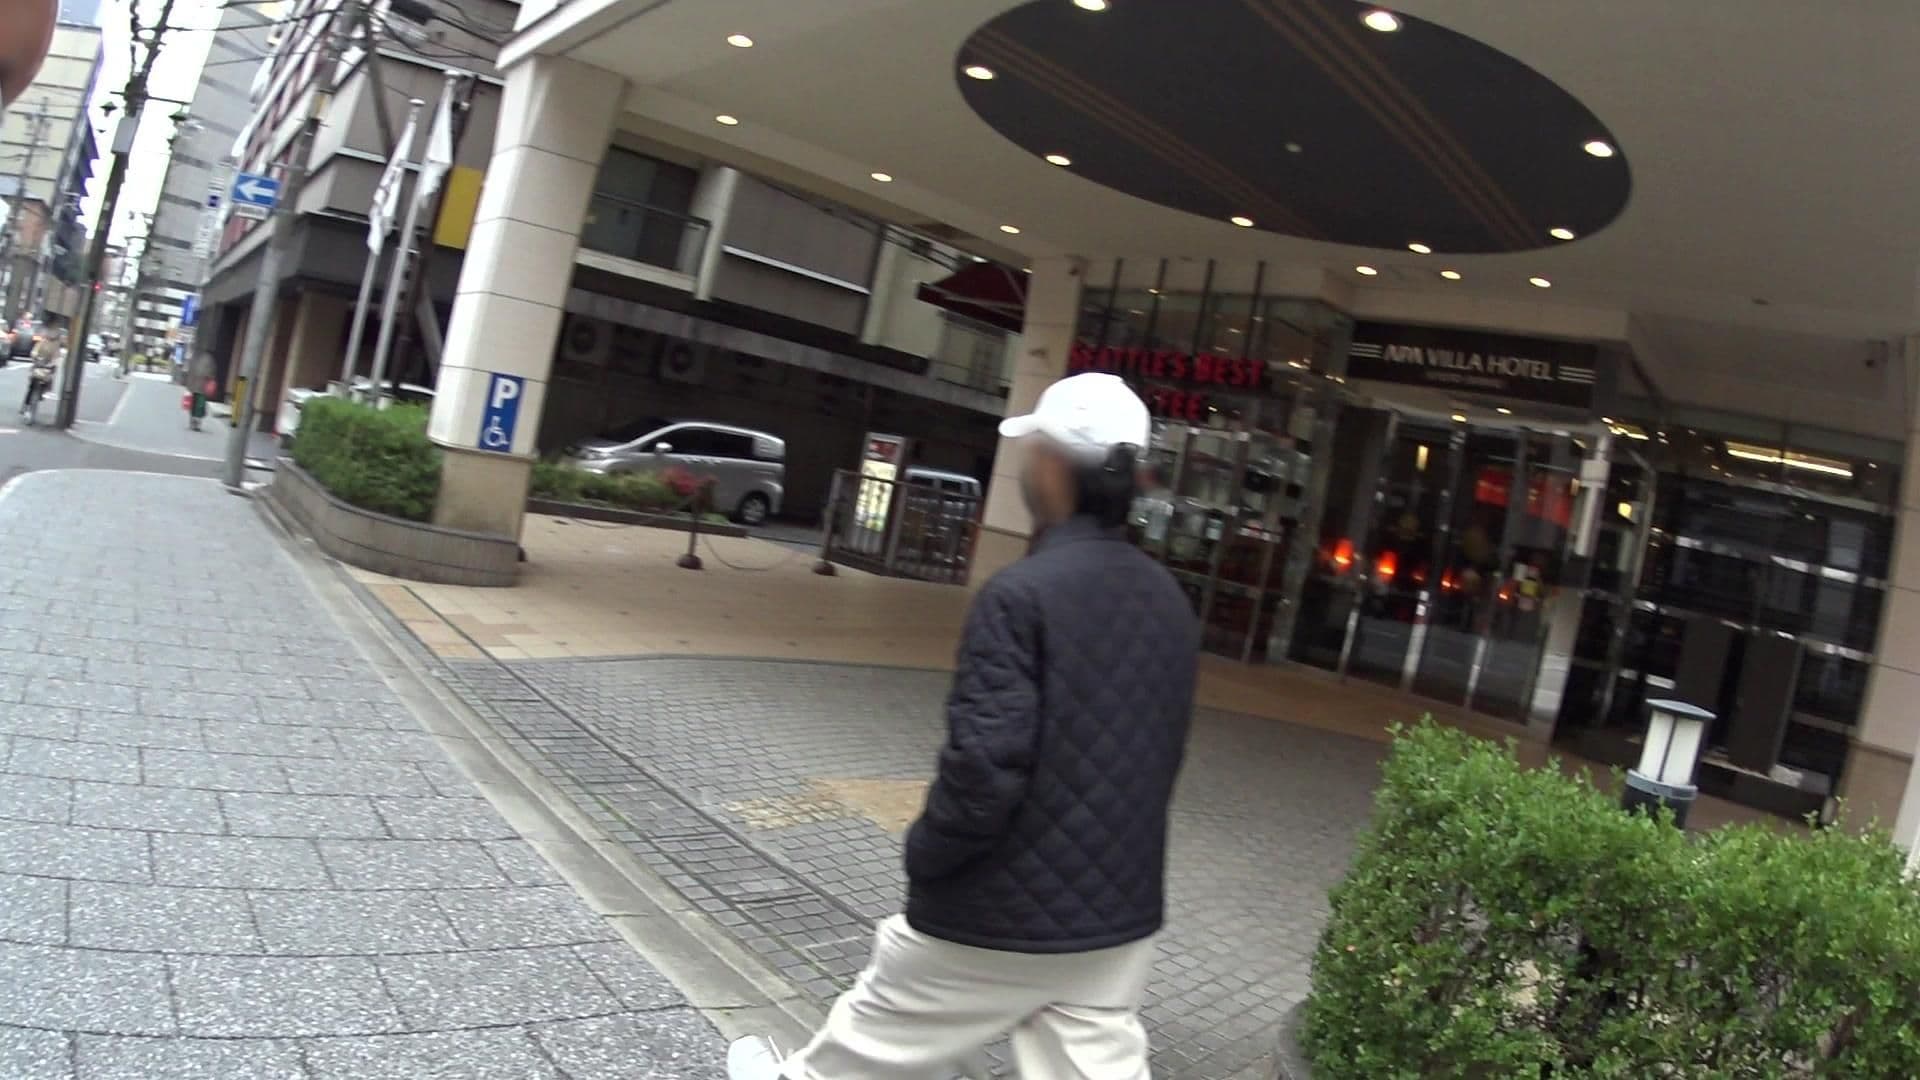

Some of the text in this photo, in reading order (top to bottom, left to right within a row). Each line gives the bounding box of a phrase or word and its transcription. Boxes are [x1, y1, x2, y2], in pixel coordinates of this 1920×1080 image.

[1194, 351, 1265, 386] BEST
[1427, 348, 1484, 373] VILLA
[1487, 355, 1554, 381] HOTEL
[491, 377, 519, 409] P
